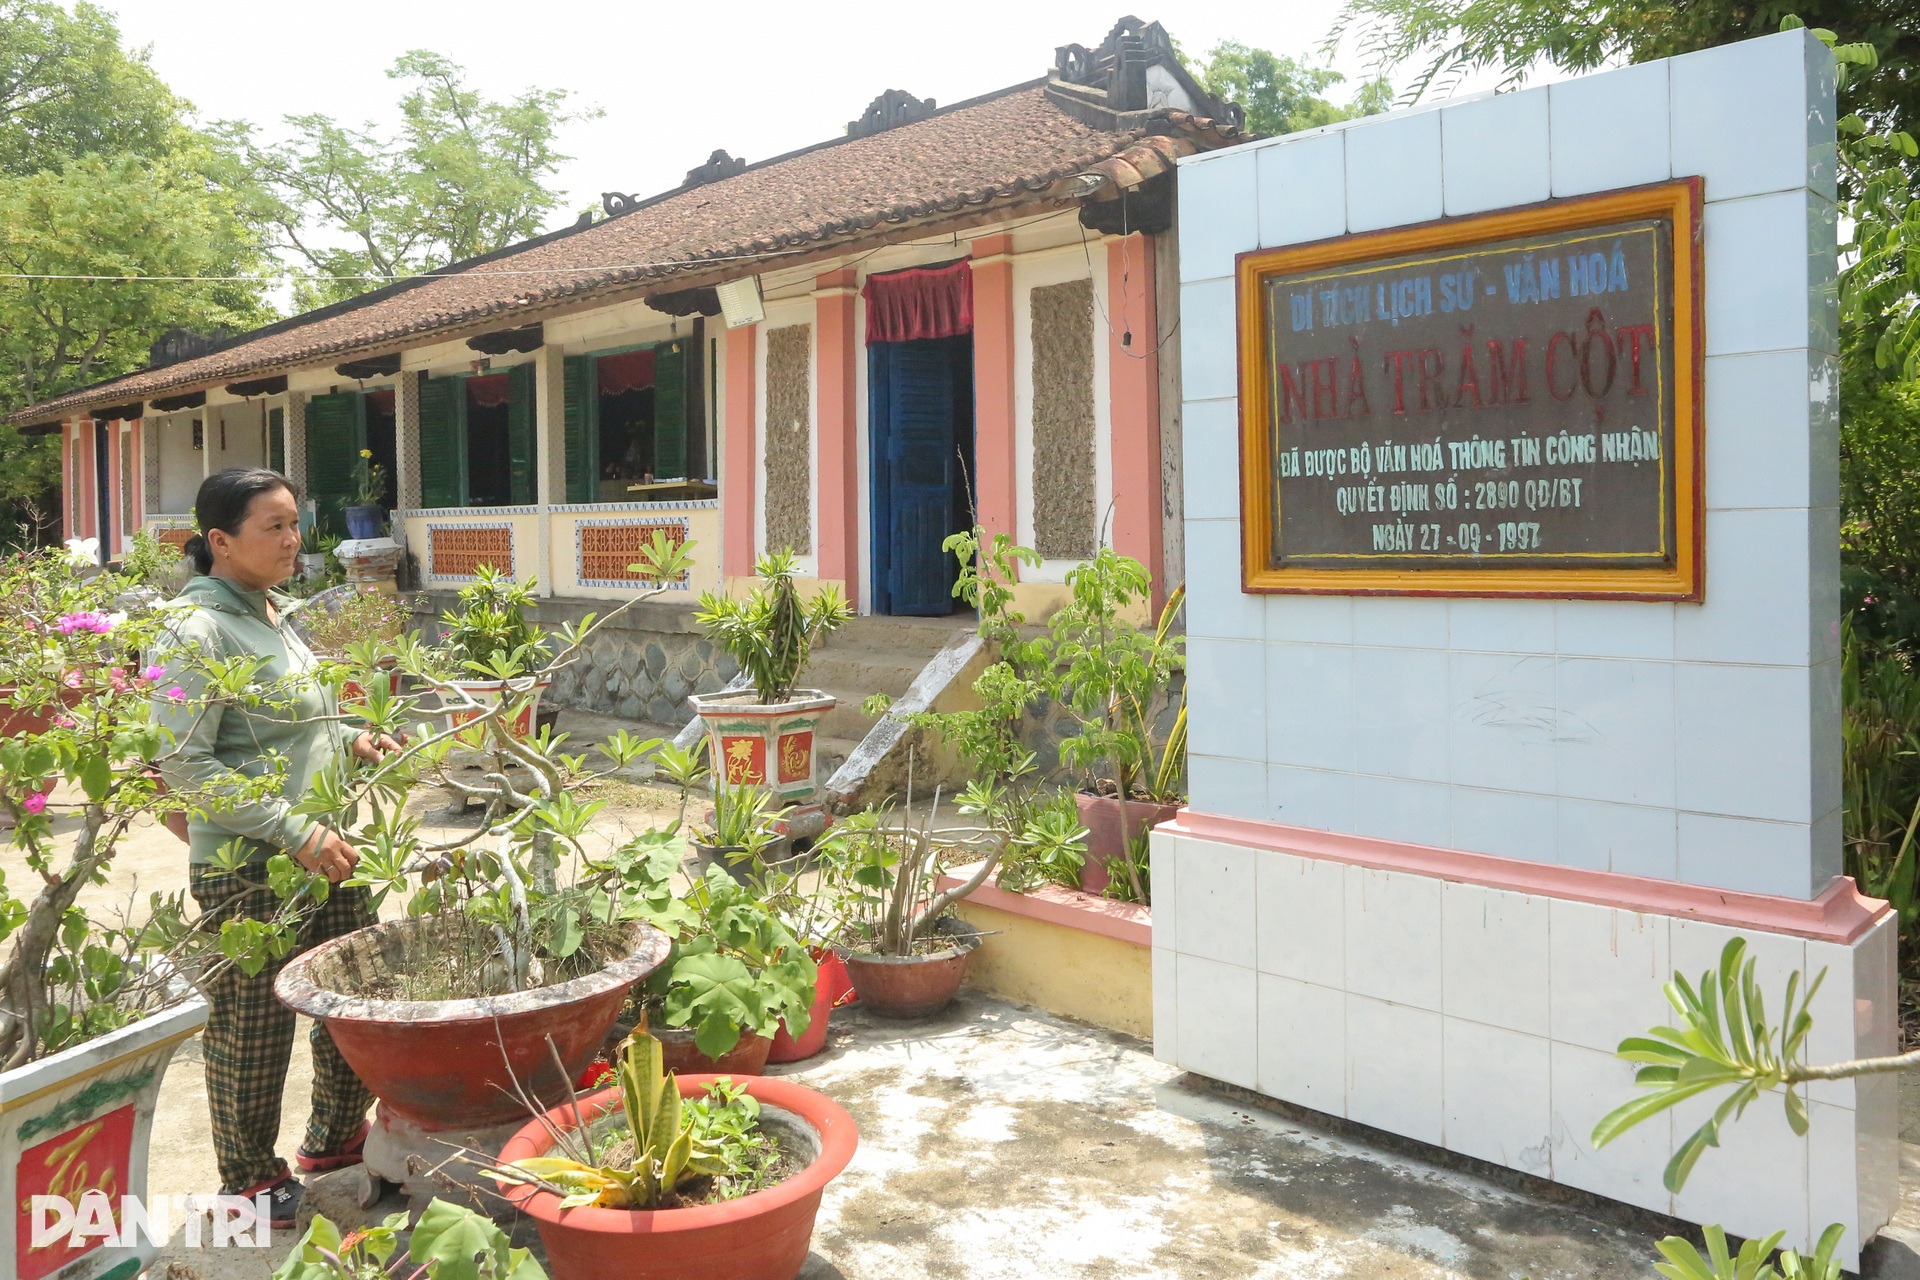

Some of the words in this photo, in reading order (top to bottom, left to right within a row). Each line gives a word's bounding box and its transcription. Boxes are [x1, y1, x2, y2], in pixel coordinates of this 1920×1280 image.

[1319, 281, 1371, 328] TÍCH
[1377, 275, 1434, 327] LỊCH
[1503, 252, 1561, 305] VĂN
[1568, 240, 1629, 297] HOÁ
[1278, 334, 1371, 424] NHÀ
[1382, 322, 1532, 415] TRĂM
[1545, 306, 1655, 424] CỘT
[1280, 446, 1301, 478] ĐÃ
[1304, 448, 1347, 481] ĐƯỢC
[1350, 441, 1371, 480] BỘ
[1374, 439, 1407, 473] VĂN
[1410, 436, 1444, 472] HOÁ
[1447, 433, 1507, 471] THÔNG
[1545, 429, 1597, 465] CÔNG
[1601, 425, 1660, 468] NHẬN
[1336, 475, 1385, 517] QUYẾT
[1389, 480, 1431, 517] ĐỊNH
[1434, 472, 1458, 511] SỐ
[1474, 479, 1519, 510] 2890
[1524, 477, 1583, 512] QĐ/BT
[1372, 517, 1416, 552] NGÀY
[1420, 523, 1442, 551] 27
[1497, 521, 1540, 552] 1997
